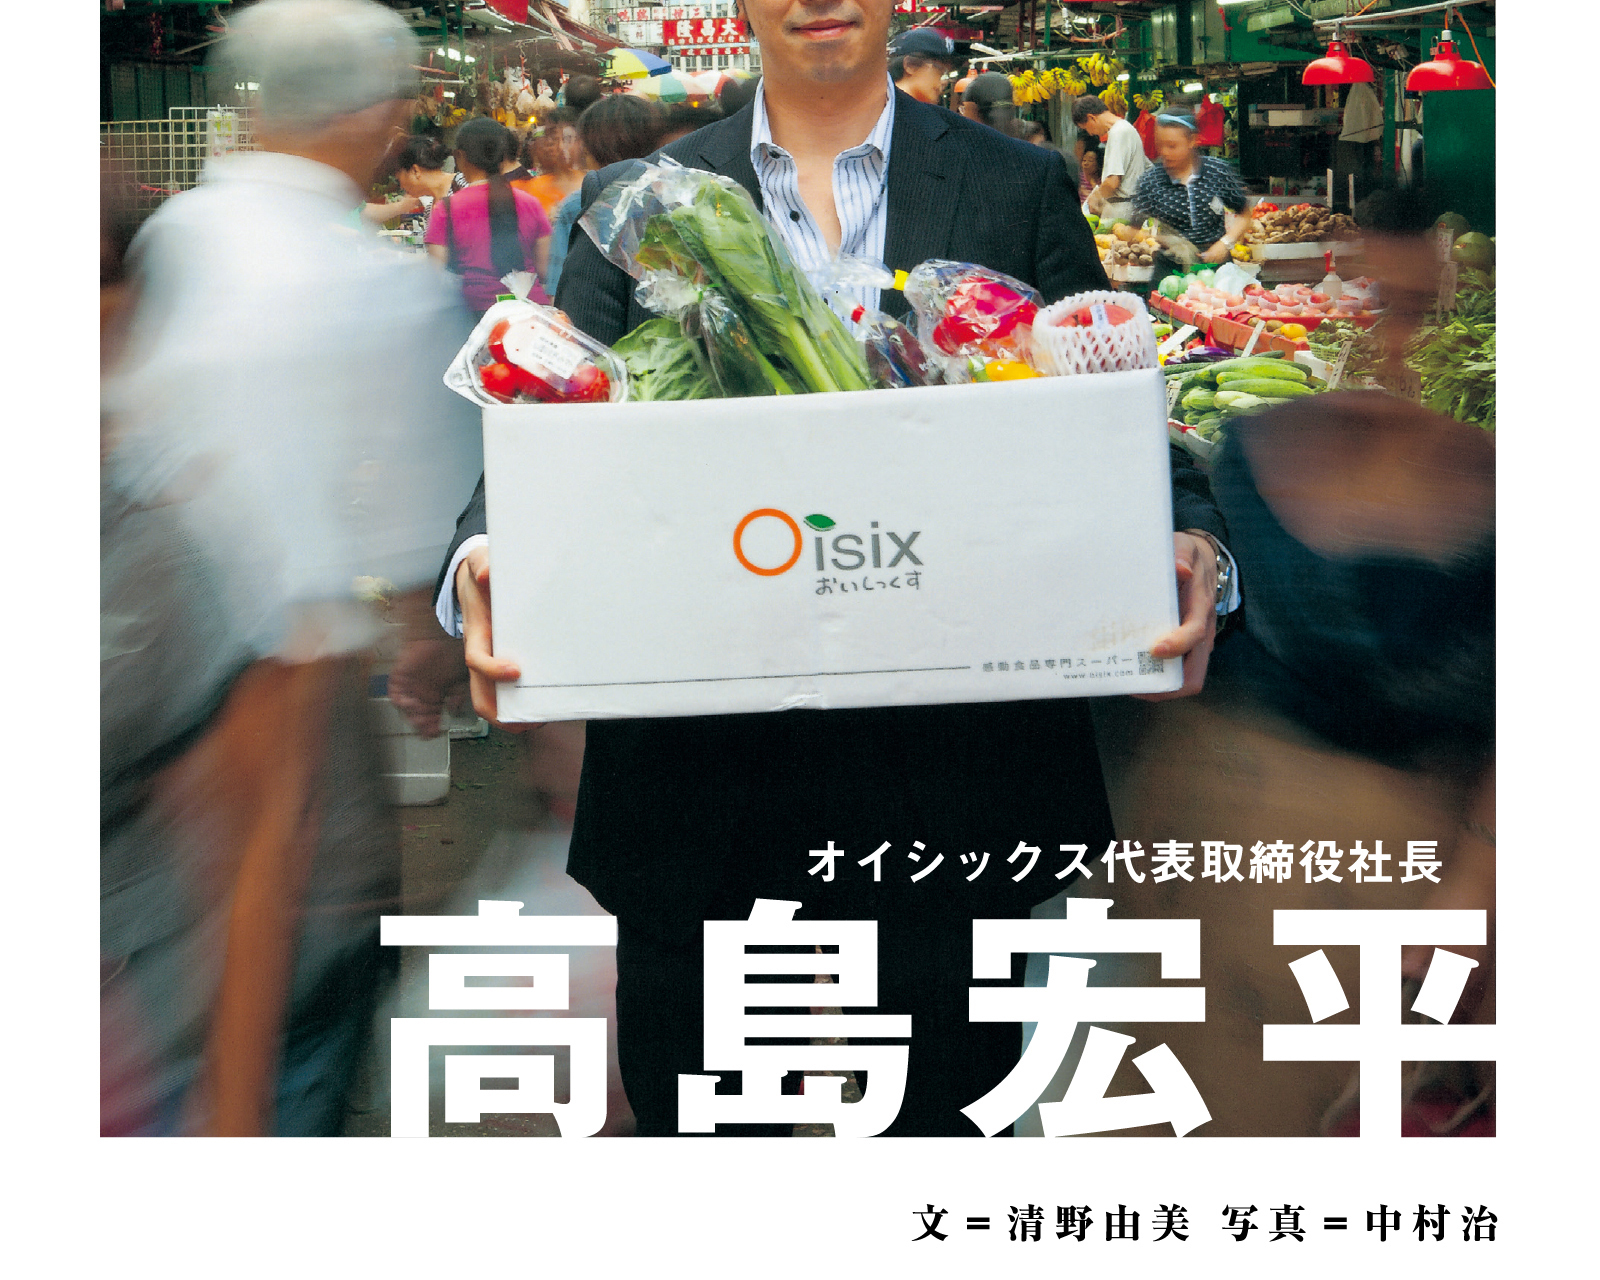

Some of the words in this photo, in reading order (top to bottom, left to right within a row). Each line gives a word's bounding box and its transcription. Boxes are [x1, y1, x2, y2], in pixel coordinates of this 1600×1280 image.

[733, 508, 924, 577] Oisix
[815, 570, 921, 596] おいしっくす
